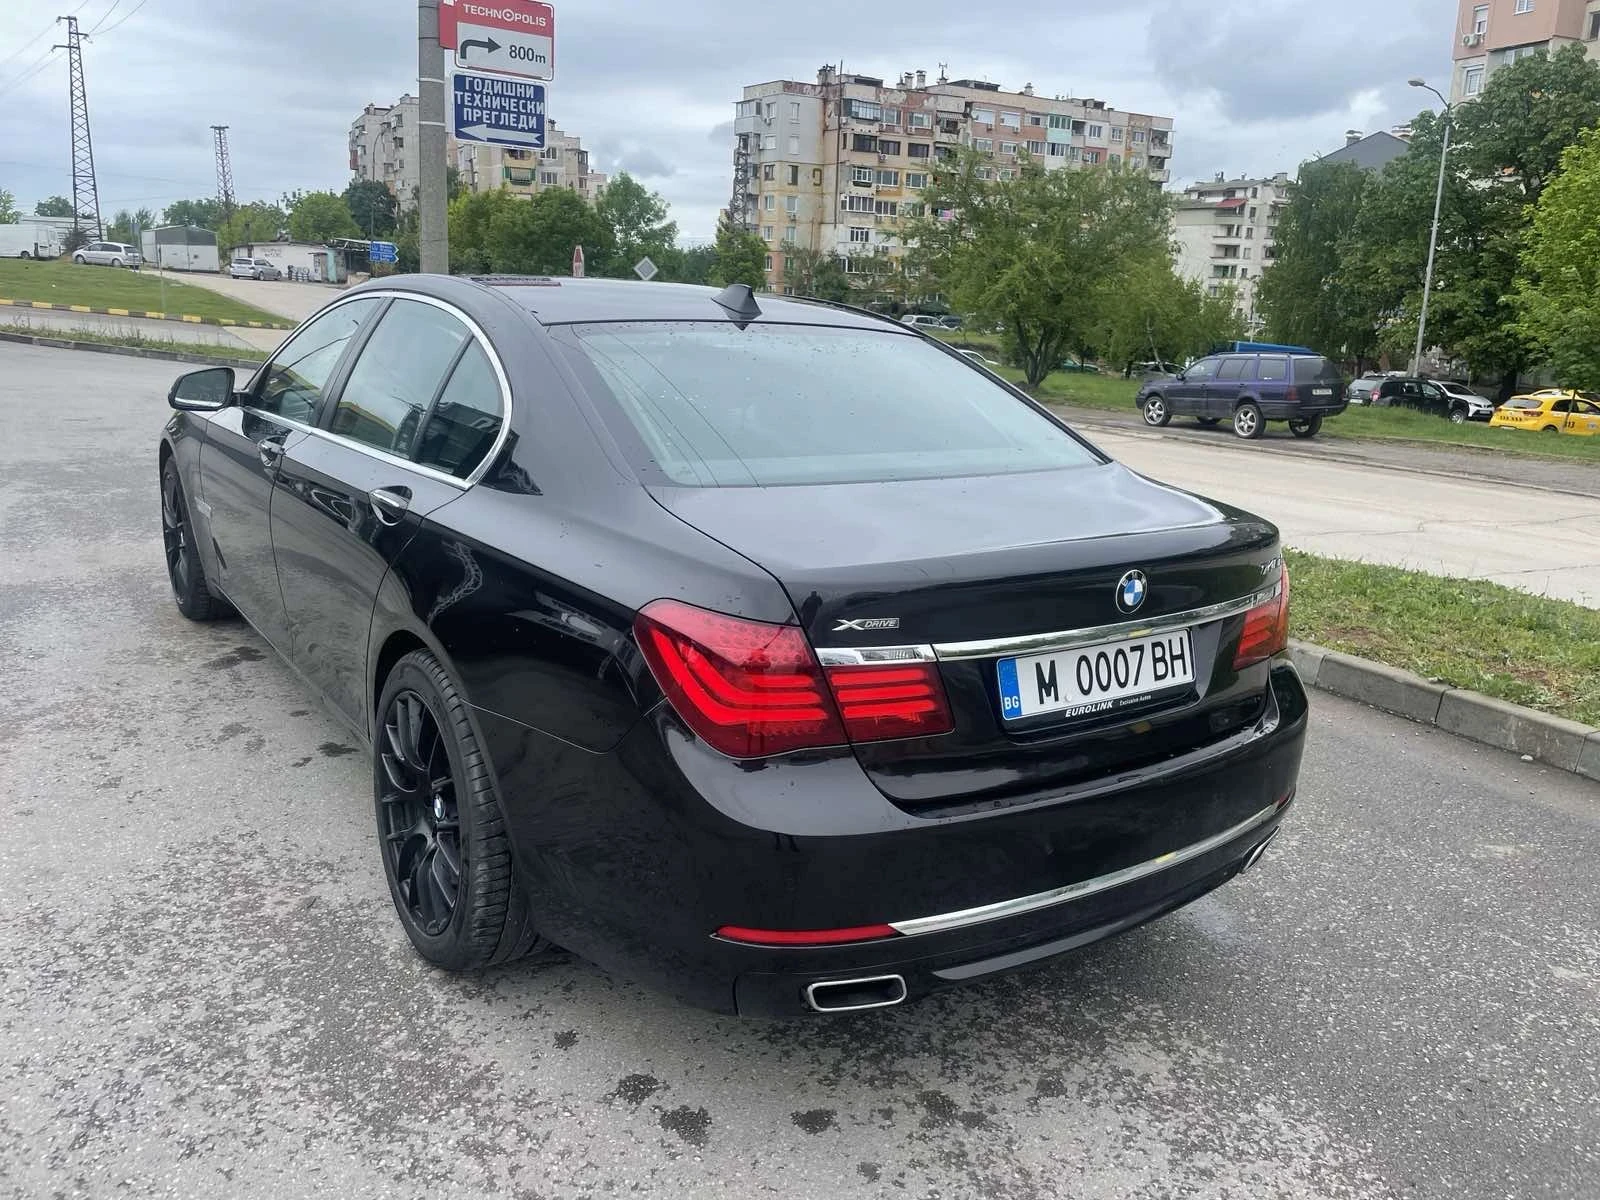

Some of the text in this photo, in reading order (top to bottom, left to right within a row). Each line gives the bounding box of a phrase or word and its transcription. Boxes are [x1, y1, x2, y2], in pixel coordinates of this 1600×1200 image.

[462, 3, 546, 27] TECHNOPOLIS
[509, 45, 546, 63] 800m
[465, 77, 534, 98] ГОДИШНИ
[455, 91, 544, 115] ТЕХНИЧЕСКИ
[463, 107, 537, 130] ПРЕГЛЕДИ
[1035, 637, 1188, 705] M 0007 BH
[1004, 696, 1020, 710] BG
[1065, 700, 1114, 718] EUROLINK
